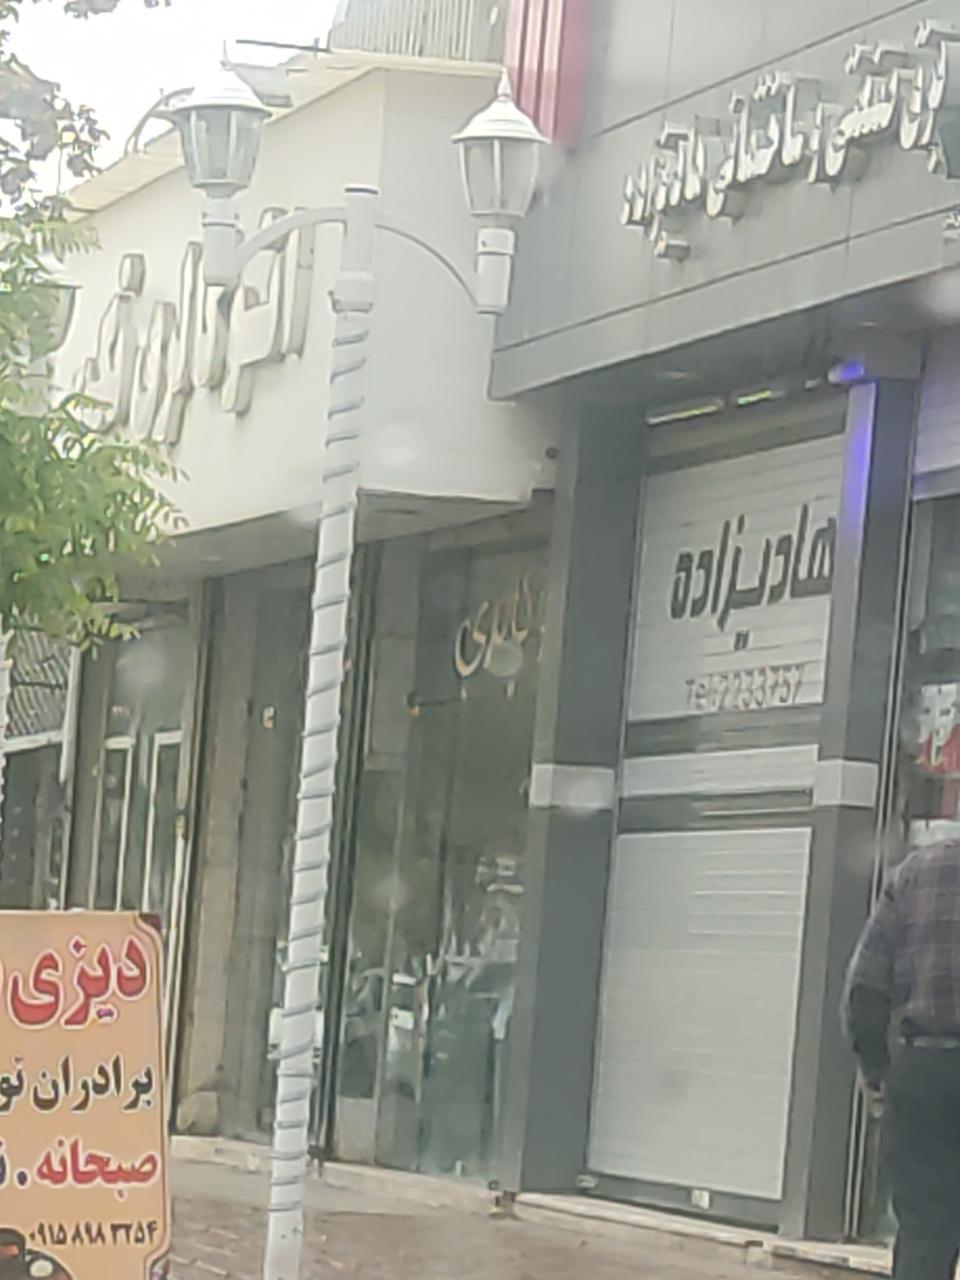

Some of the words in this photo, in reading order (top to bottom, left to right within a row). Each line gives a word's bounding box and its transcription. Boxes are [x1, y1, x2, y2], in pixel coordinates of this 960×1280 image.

[9, 935, 151, 1027] دیزی
[32, 1054, 154, 1111] برادران
[35, 1138, 159, 1198] صبحانه
